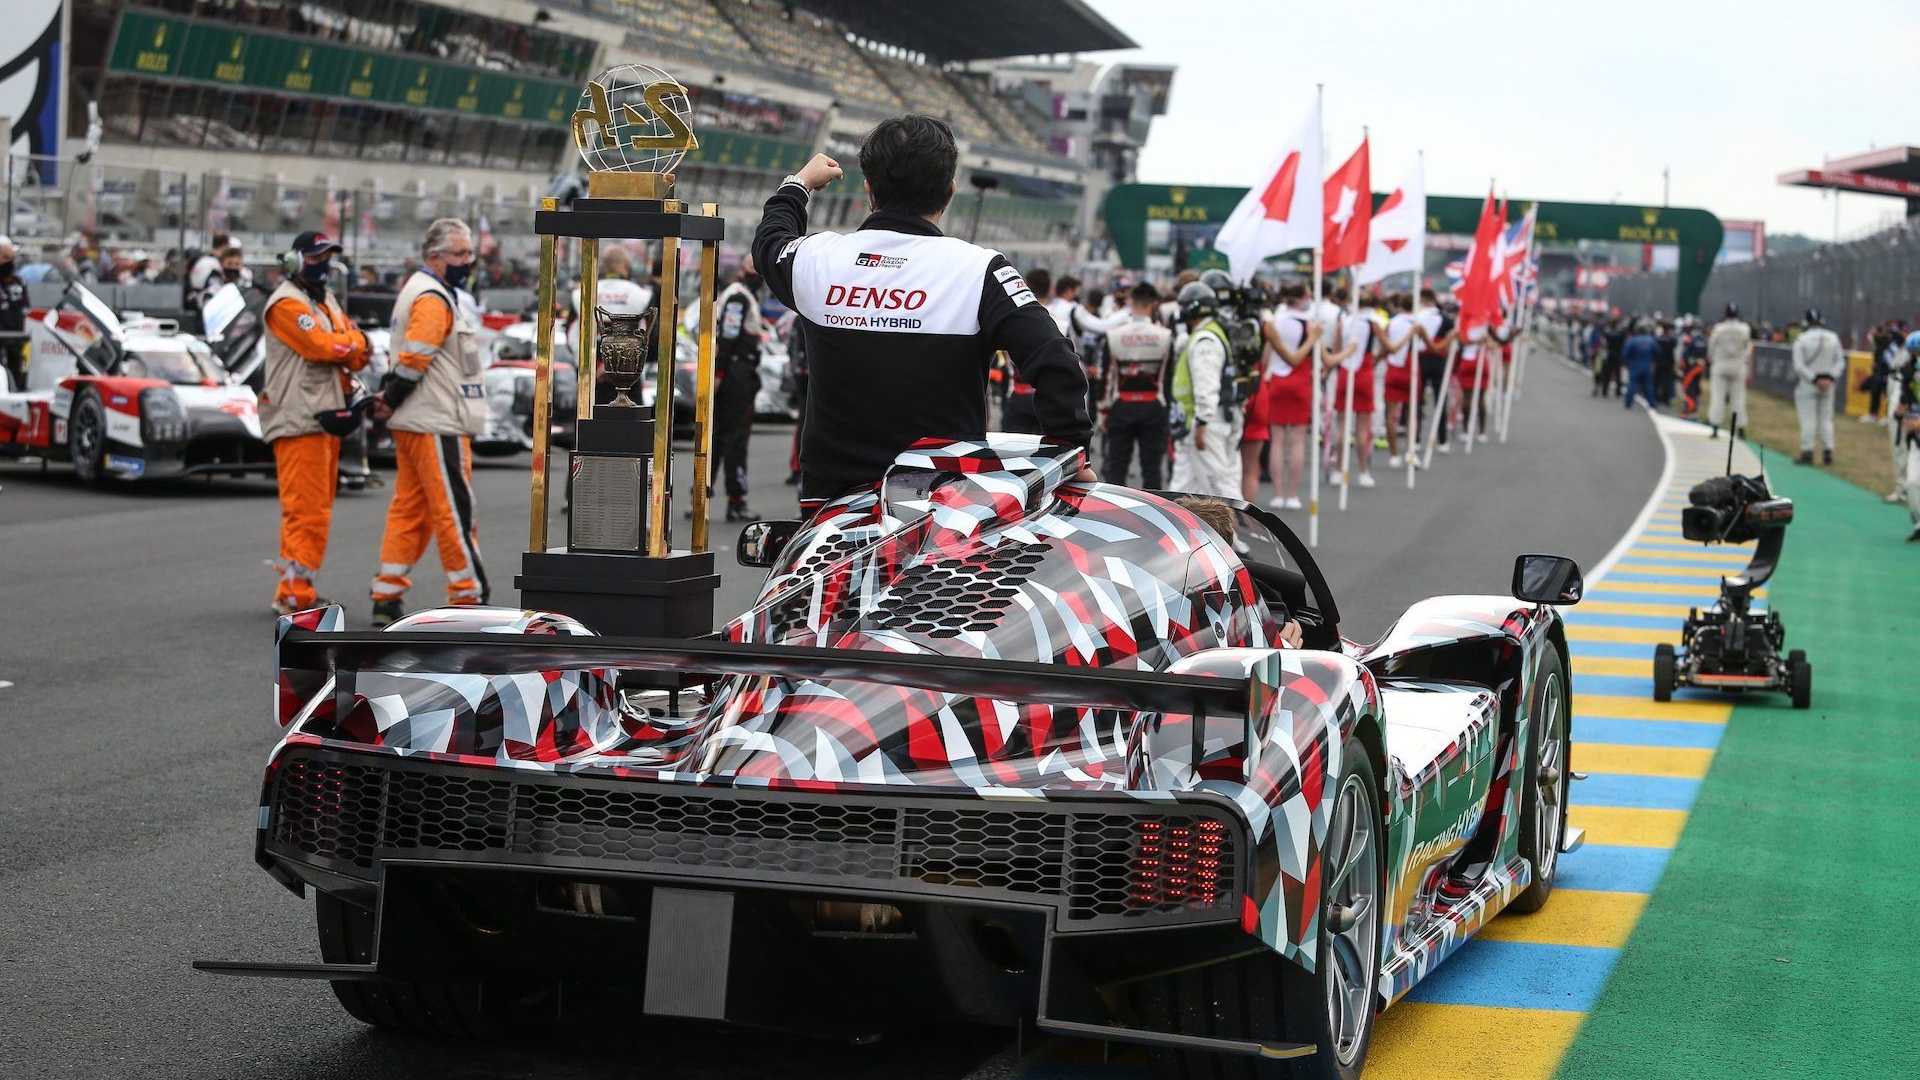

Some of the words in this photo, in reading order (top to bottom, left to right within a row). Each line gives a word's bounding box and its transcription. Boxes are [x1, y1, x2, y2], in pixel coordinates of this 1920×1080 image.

[1147, 206, 1208, 220] ROLEX
[1619, 226, 1679, 242] ROLEX
[857, 257, 880, 267] GR
[825, 285, 927, 310] DENSO
[824, 314, 868, 327] TOYOTA
[870, 317, 922, 329] HYBRID
[1407, 822, 1456, 873] RACING
